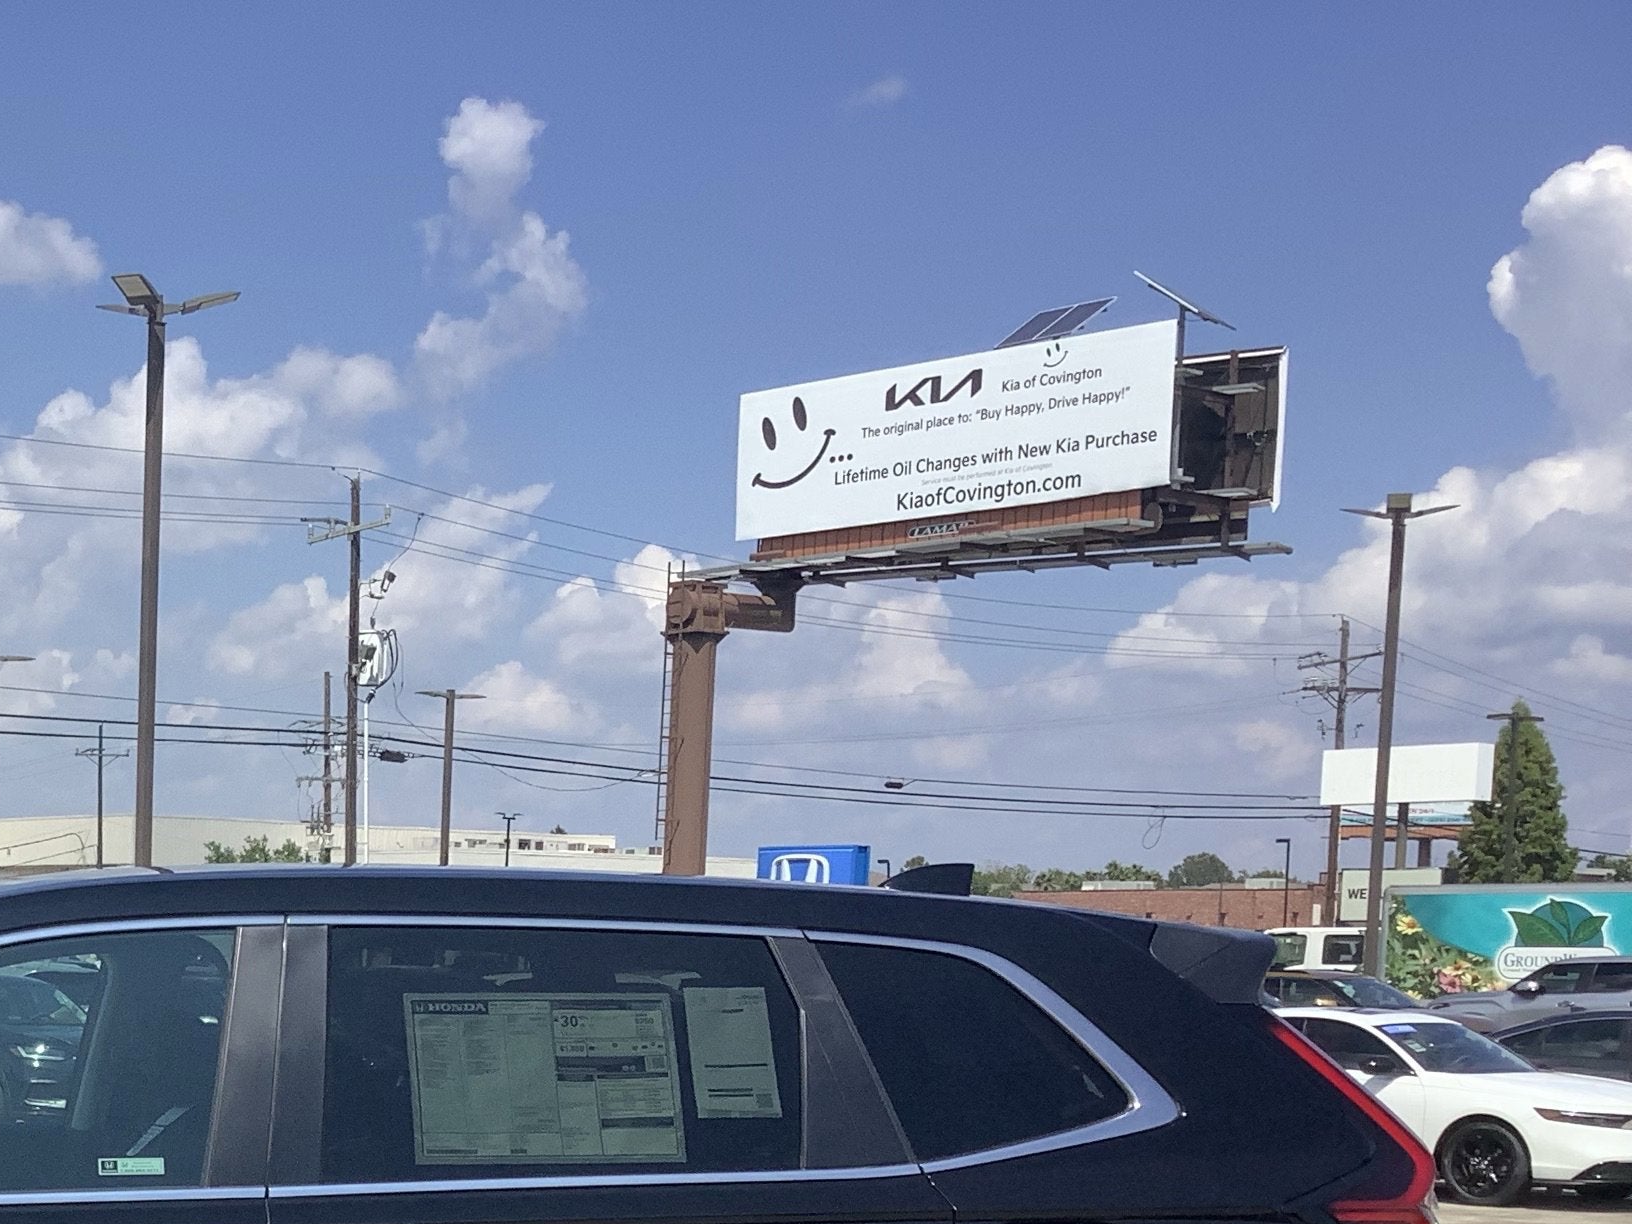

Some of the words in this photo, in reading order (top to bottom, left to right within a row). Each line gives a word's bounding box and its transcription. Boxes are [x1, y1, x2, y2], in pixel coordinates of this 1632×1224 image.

[885, 368, 983, 411] KIA
[1002, 379, 1020, 392] Kia
[1024, 376, 1037, 389] of
[1040, 368, 1102, 386] Covington
[862, 427, 881, 439] The
[883, 418, 923, 436] original
[926, 415, 955, 431] place
[958, 412, 972, 424] to:
[1005, 401, 1044, 417] Happy,
[1048, 396, 1079, 410] Drive
[834, 466, 889, 486] Lifetime
[893, 460, 912, 477] Oil
[916, 454, 977, 473] Changes
[981, 446, 1013, 464] with
[1018, 443, 1051, 460] New
[1056, 437, 1080, 454] Kia
[1085, 430, 1158, 450] Purchase
[896, 474, 1081, 511] KiaofCovington.com
[1348, 888, 1367, 900] WE
[428, 1002, 487, 1013] HONDA
[560, 1015, 579, 1028] 30
